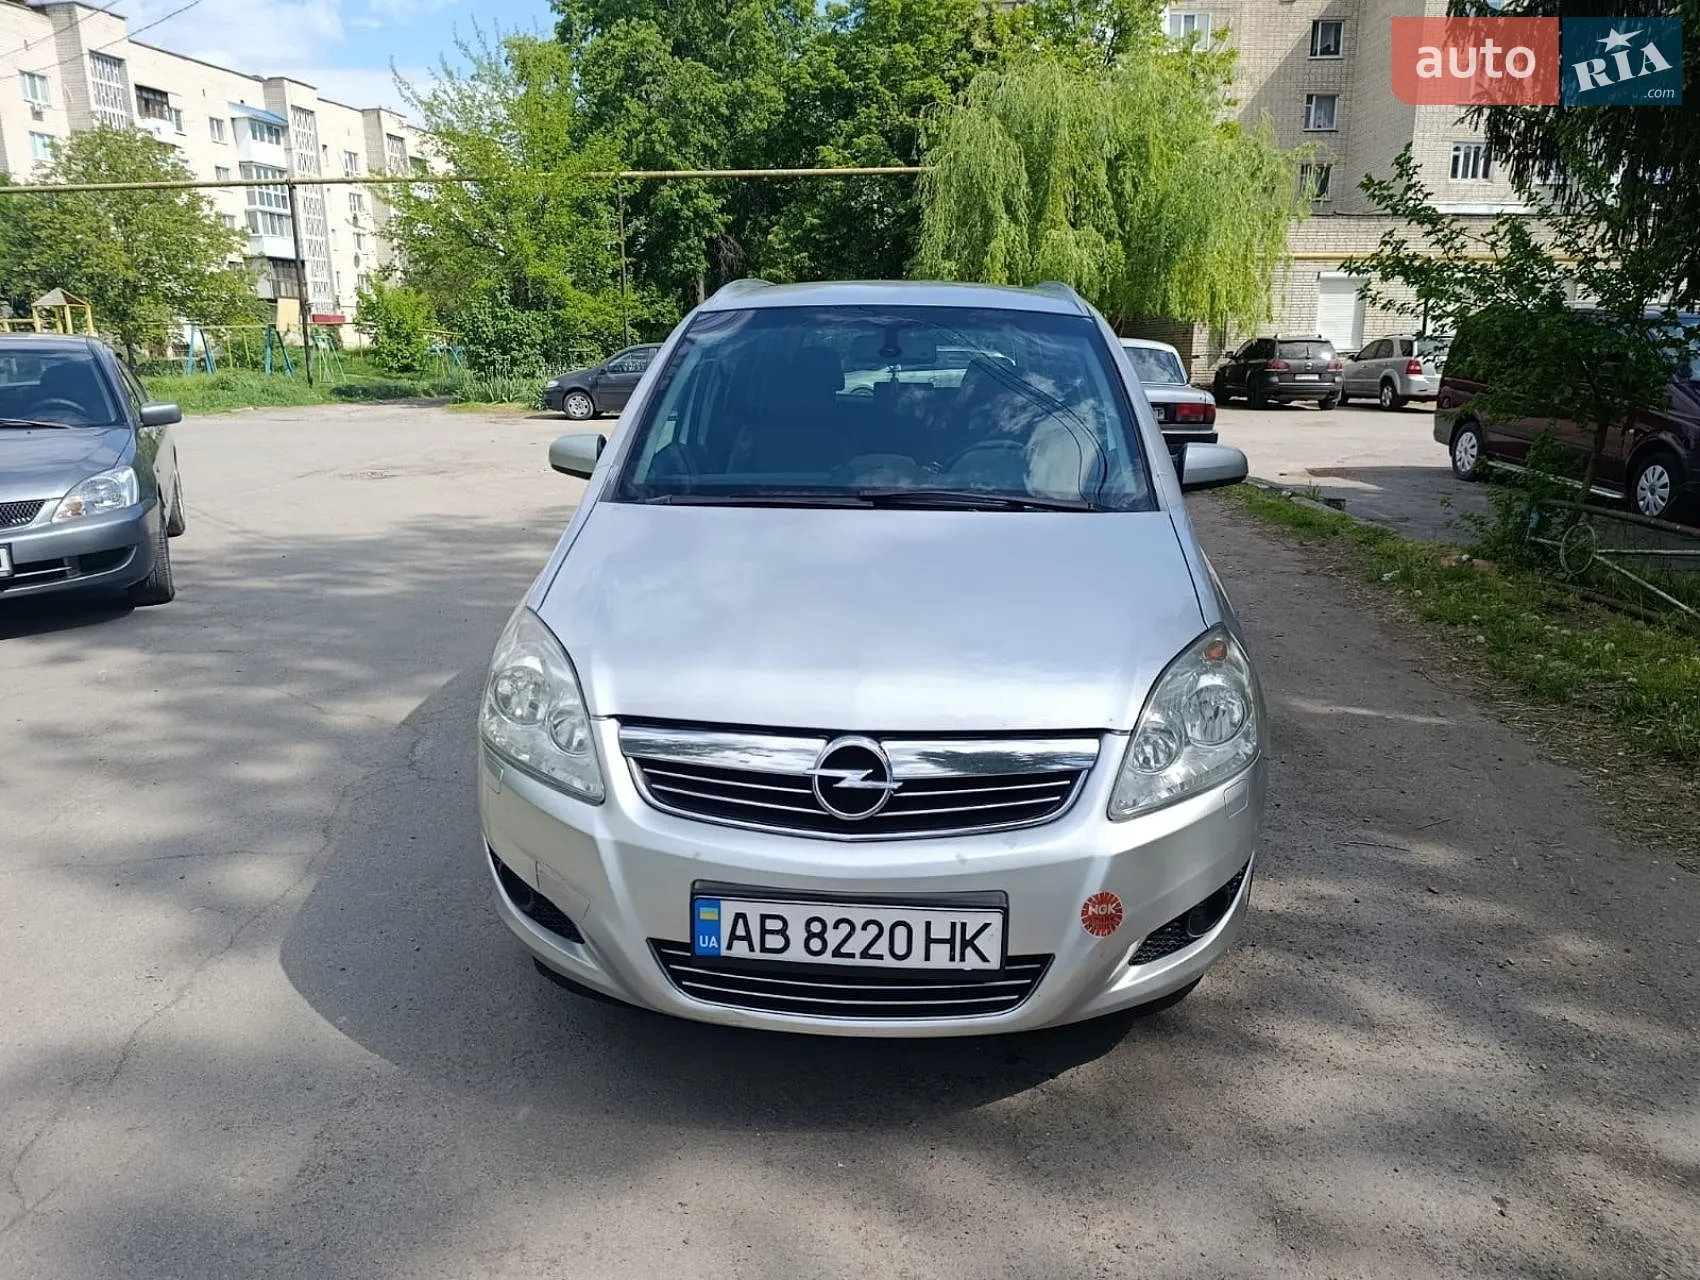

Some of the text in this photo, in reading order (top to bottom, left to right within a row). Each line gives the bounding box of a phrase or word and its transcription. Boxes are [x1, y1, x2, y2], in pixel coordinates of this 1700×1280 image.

[1088, 903, 1116, 916] NGK
[699, 935, 718, 948] UA
[725, 912, 992, 963] AB 8220 HK
